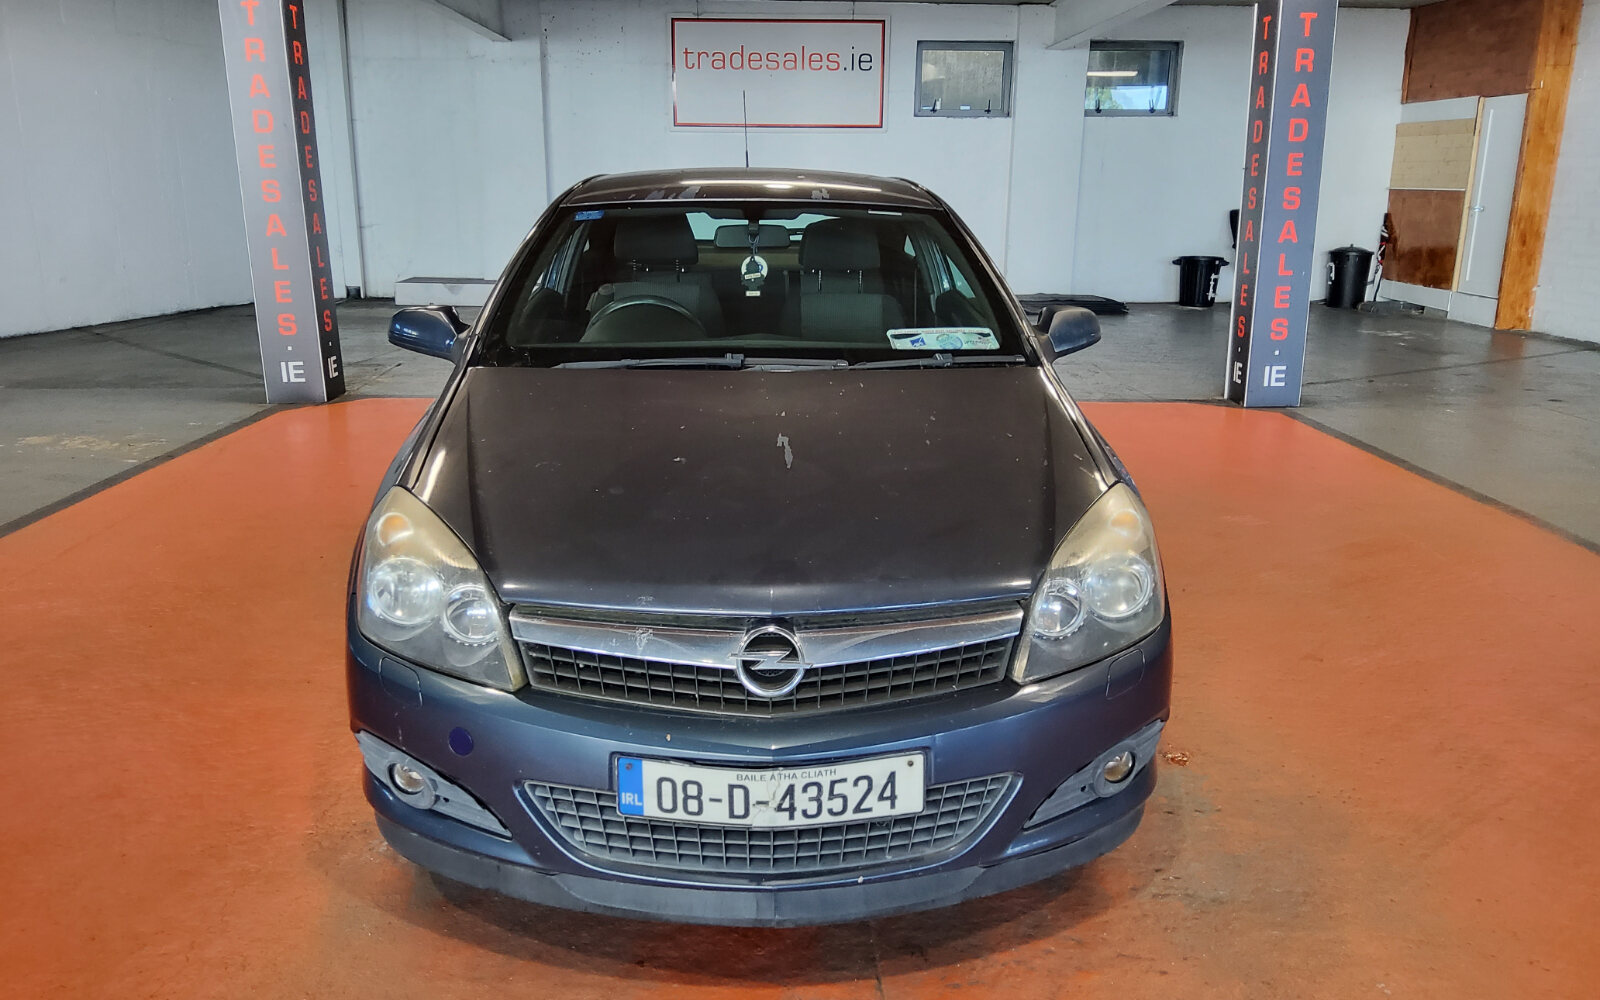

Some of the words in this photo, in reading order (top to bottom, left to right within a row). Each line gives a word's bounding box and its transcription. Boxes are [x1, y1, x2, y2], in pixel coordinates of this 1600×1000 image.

[682, 44, 873, 72] tradesales.ie
[736, 773, 766, 782] BAILE
[801, 768, 837, 779] CLIATH
[621, 791, 643, 806] IRL
[656, 770, 898, 821] 08-D-43524
